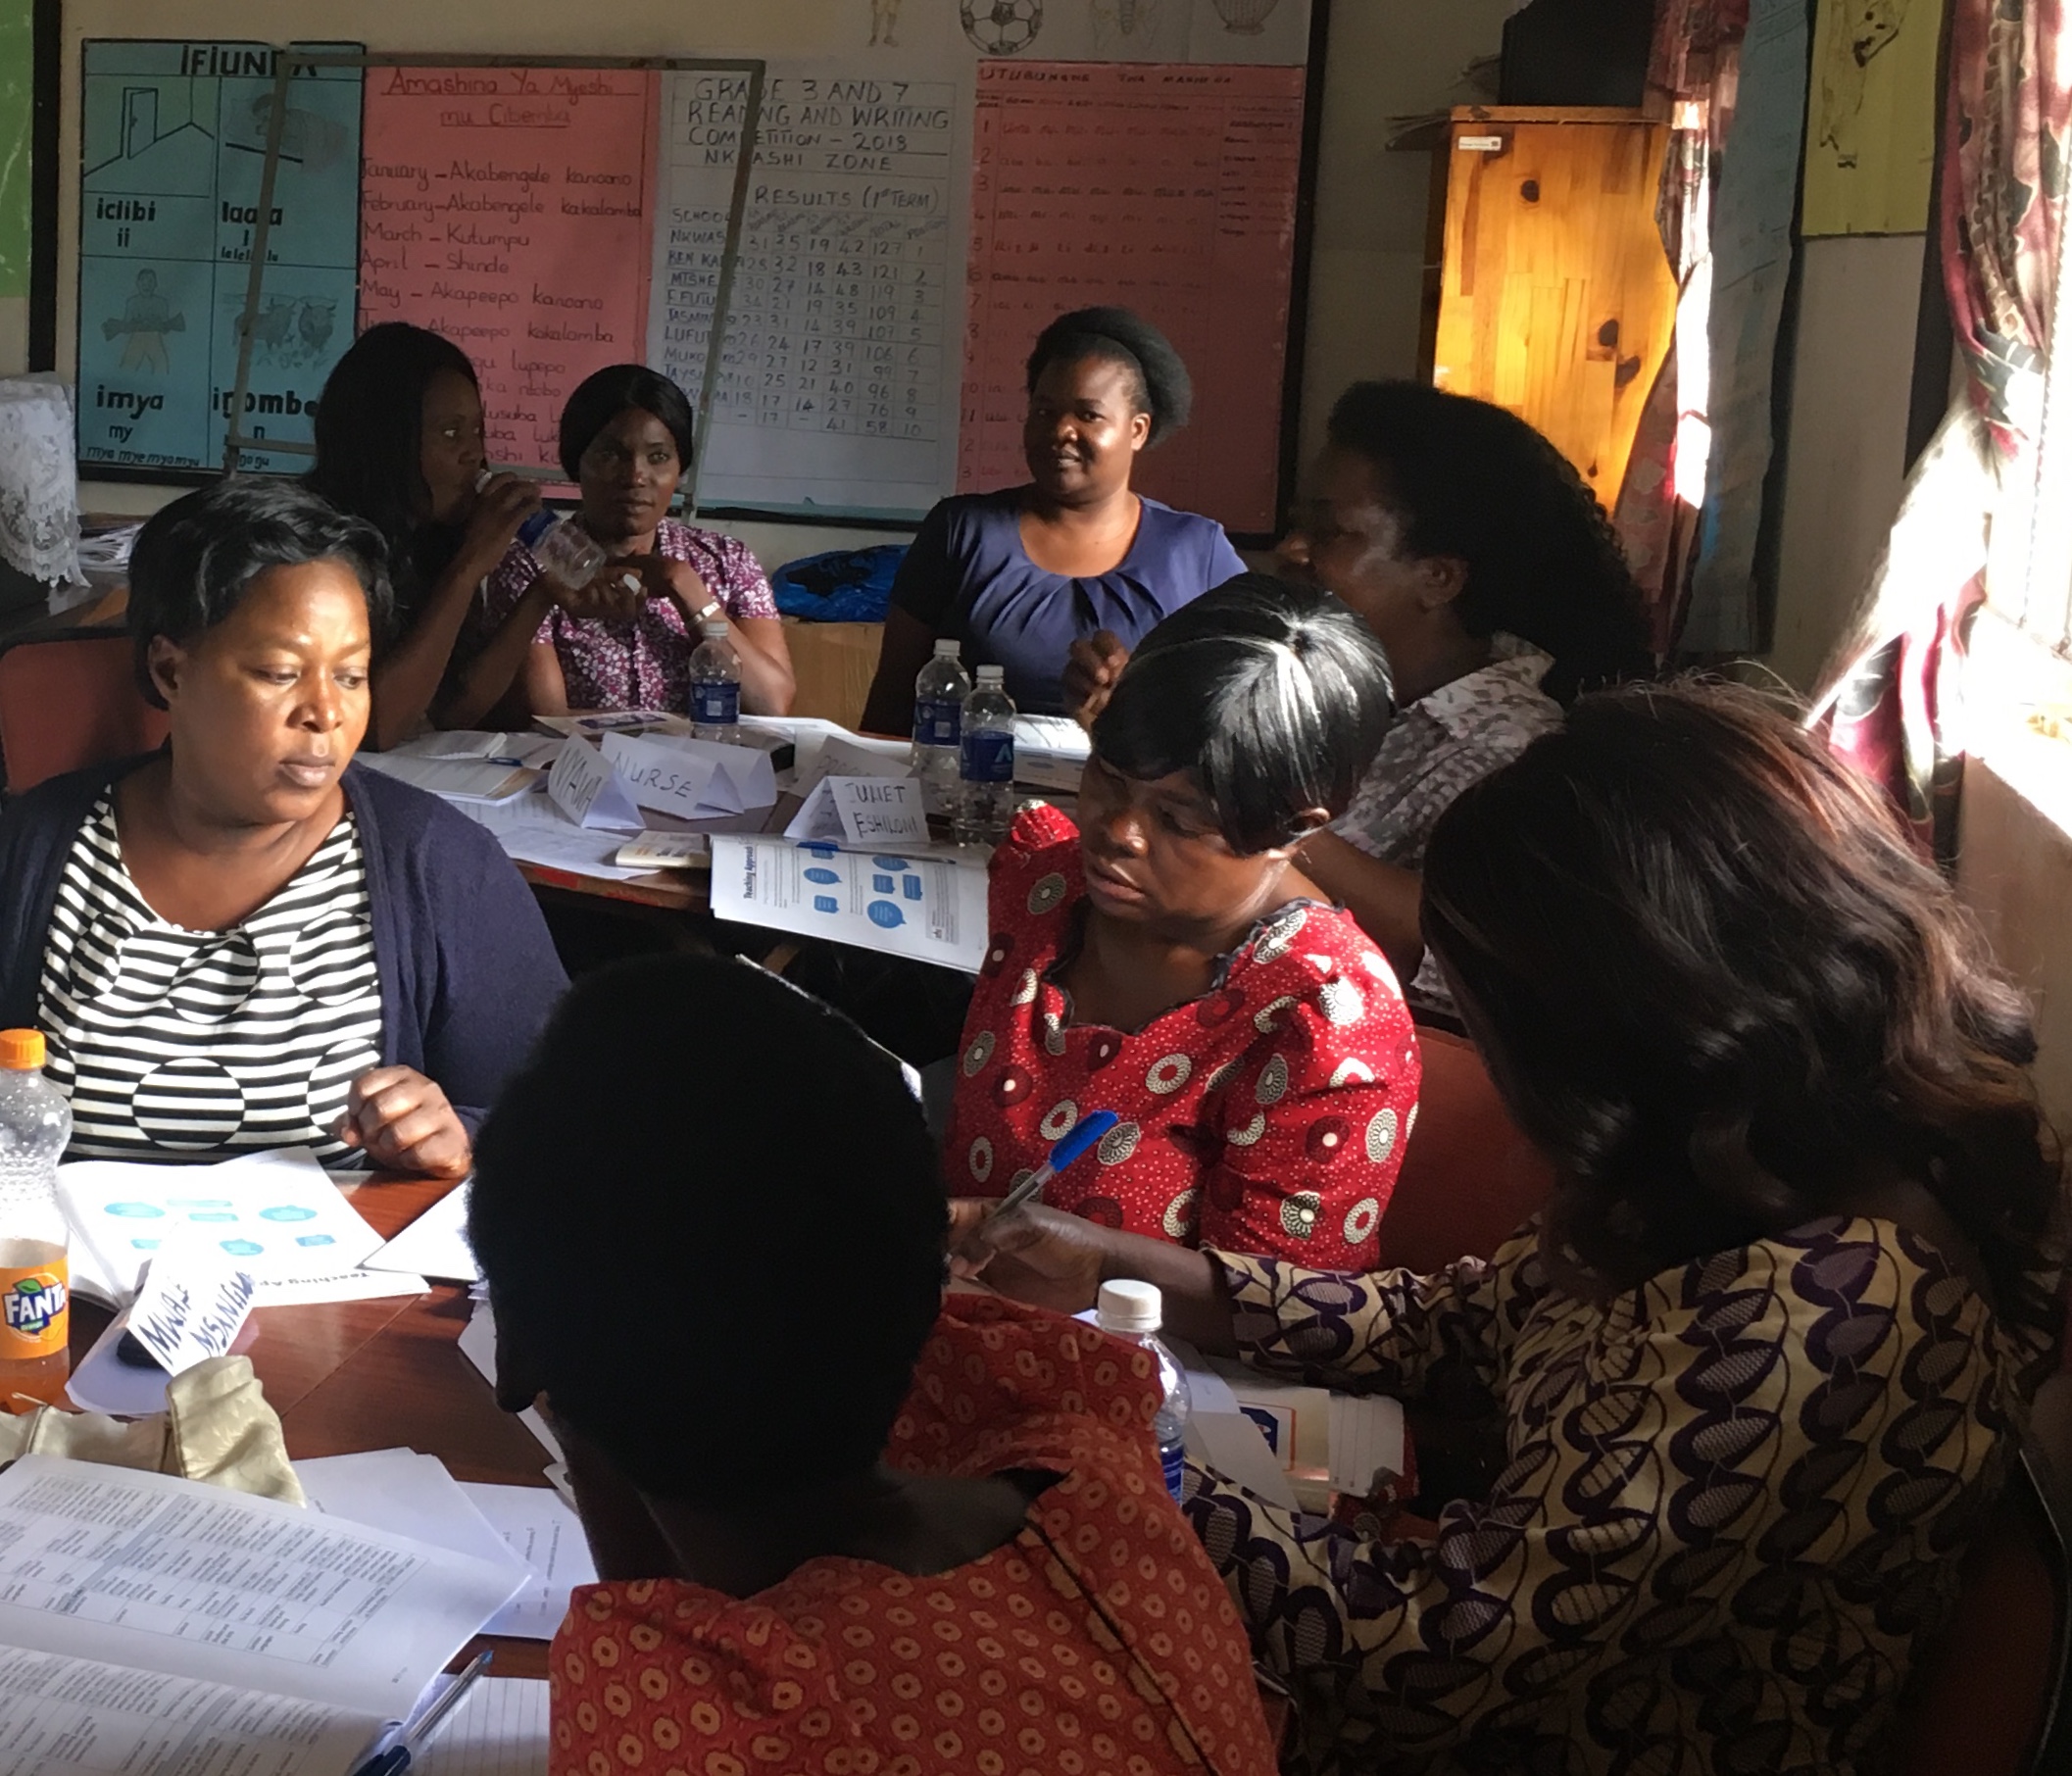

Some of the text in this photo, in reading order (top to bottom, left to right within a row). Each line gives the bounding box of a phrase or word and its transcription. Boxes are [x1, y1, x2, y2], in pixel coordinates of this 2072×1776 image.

[510, 70, 538, 94] Ya
[694, 78, 910, 104] GRAE 3 AND 7
[687, 100, 949, 129] REANG AND WRITING
[688, 126, 822, 147] COMETITION
[704, 149, 893, 172] NKASHI ZONE
[754, 185, 852, 209] RESULTS
[222, 201, 283, 226] laaa
[364, 222, 422, 242] March
[670, 228, 727, 245] NKWAS
[810, 238, 830, 253] 19
[808, 261, 827, 277] 18
[872, 264, 899, 280] 121
[362, 278, 401, 309] May
[868, 305, 896, 321] 109
[96, 383, 165, 419] imya
[108, 424, 133, 444] my
[614, 751, 692, 799] NURSE
